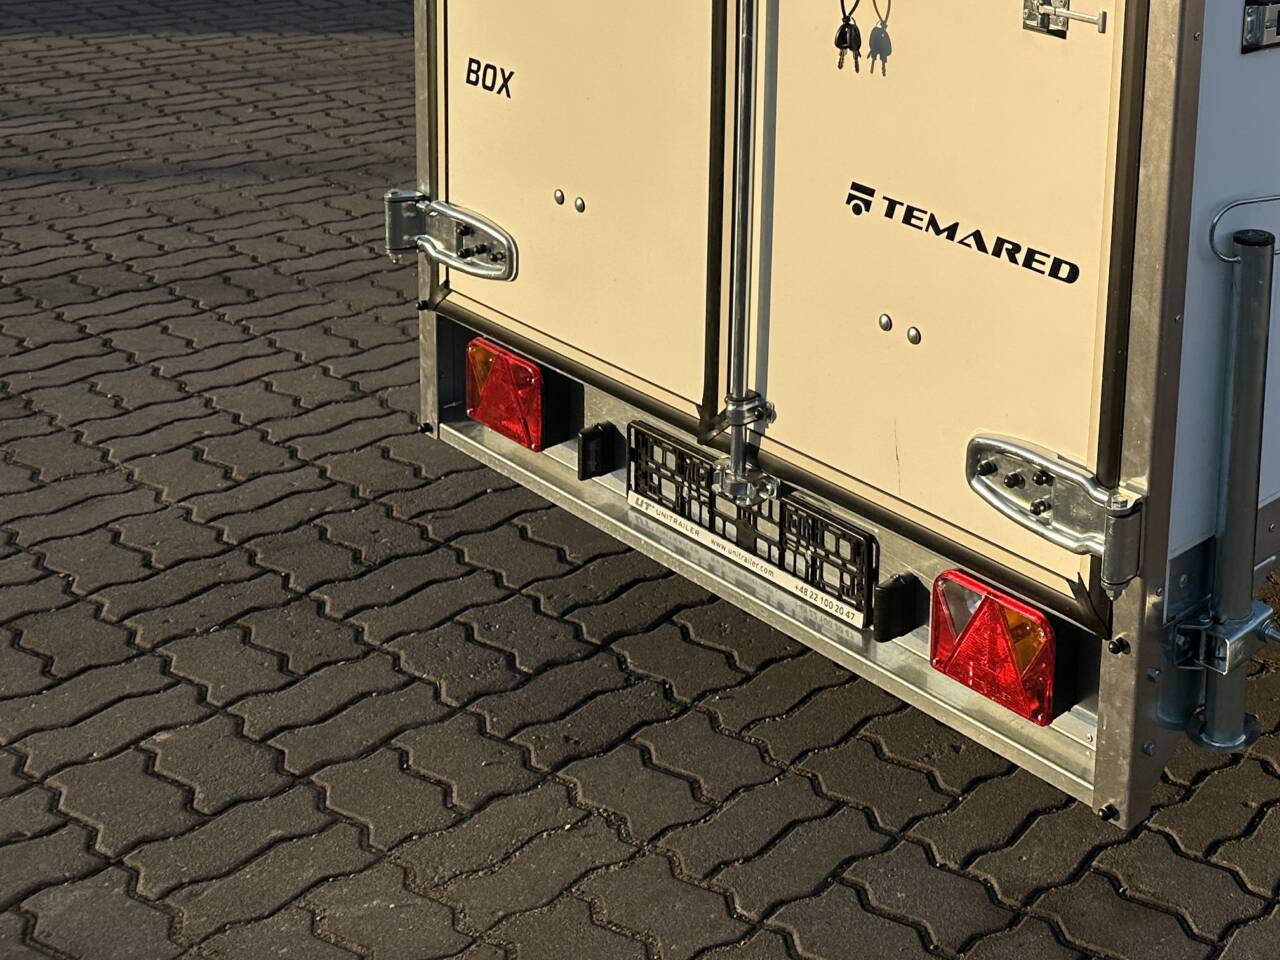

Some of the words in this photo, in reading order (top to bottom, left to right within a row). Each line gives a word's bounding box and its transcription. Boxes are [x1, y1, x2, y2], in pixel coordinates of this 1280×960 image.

[465, 57, 515, 99] BOX
[882, 195, 1081, 285] TEMARED
[656, 510, 700, 537] UNITRAILER
[710, 538, 775, 577] www.unitrailer.com
[795, 585, 809, 596] +48
[809, 590, 818, 602] 22
[820, 597, 834, 610] 100
[835, 604, 844, 616] 20
[845, 611, 856, 621] 47
